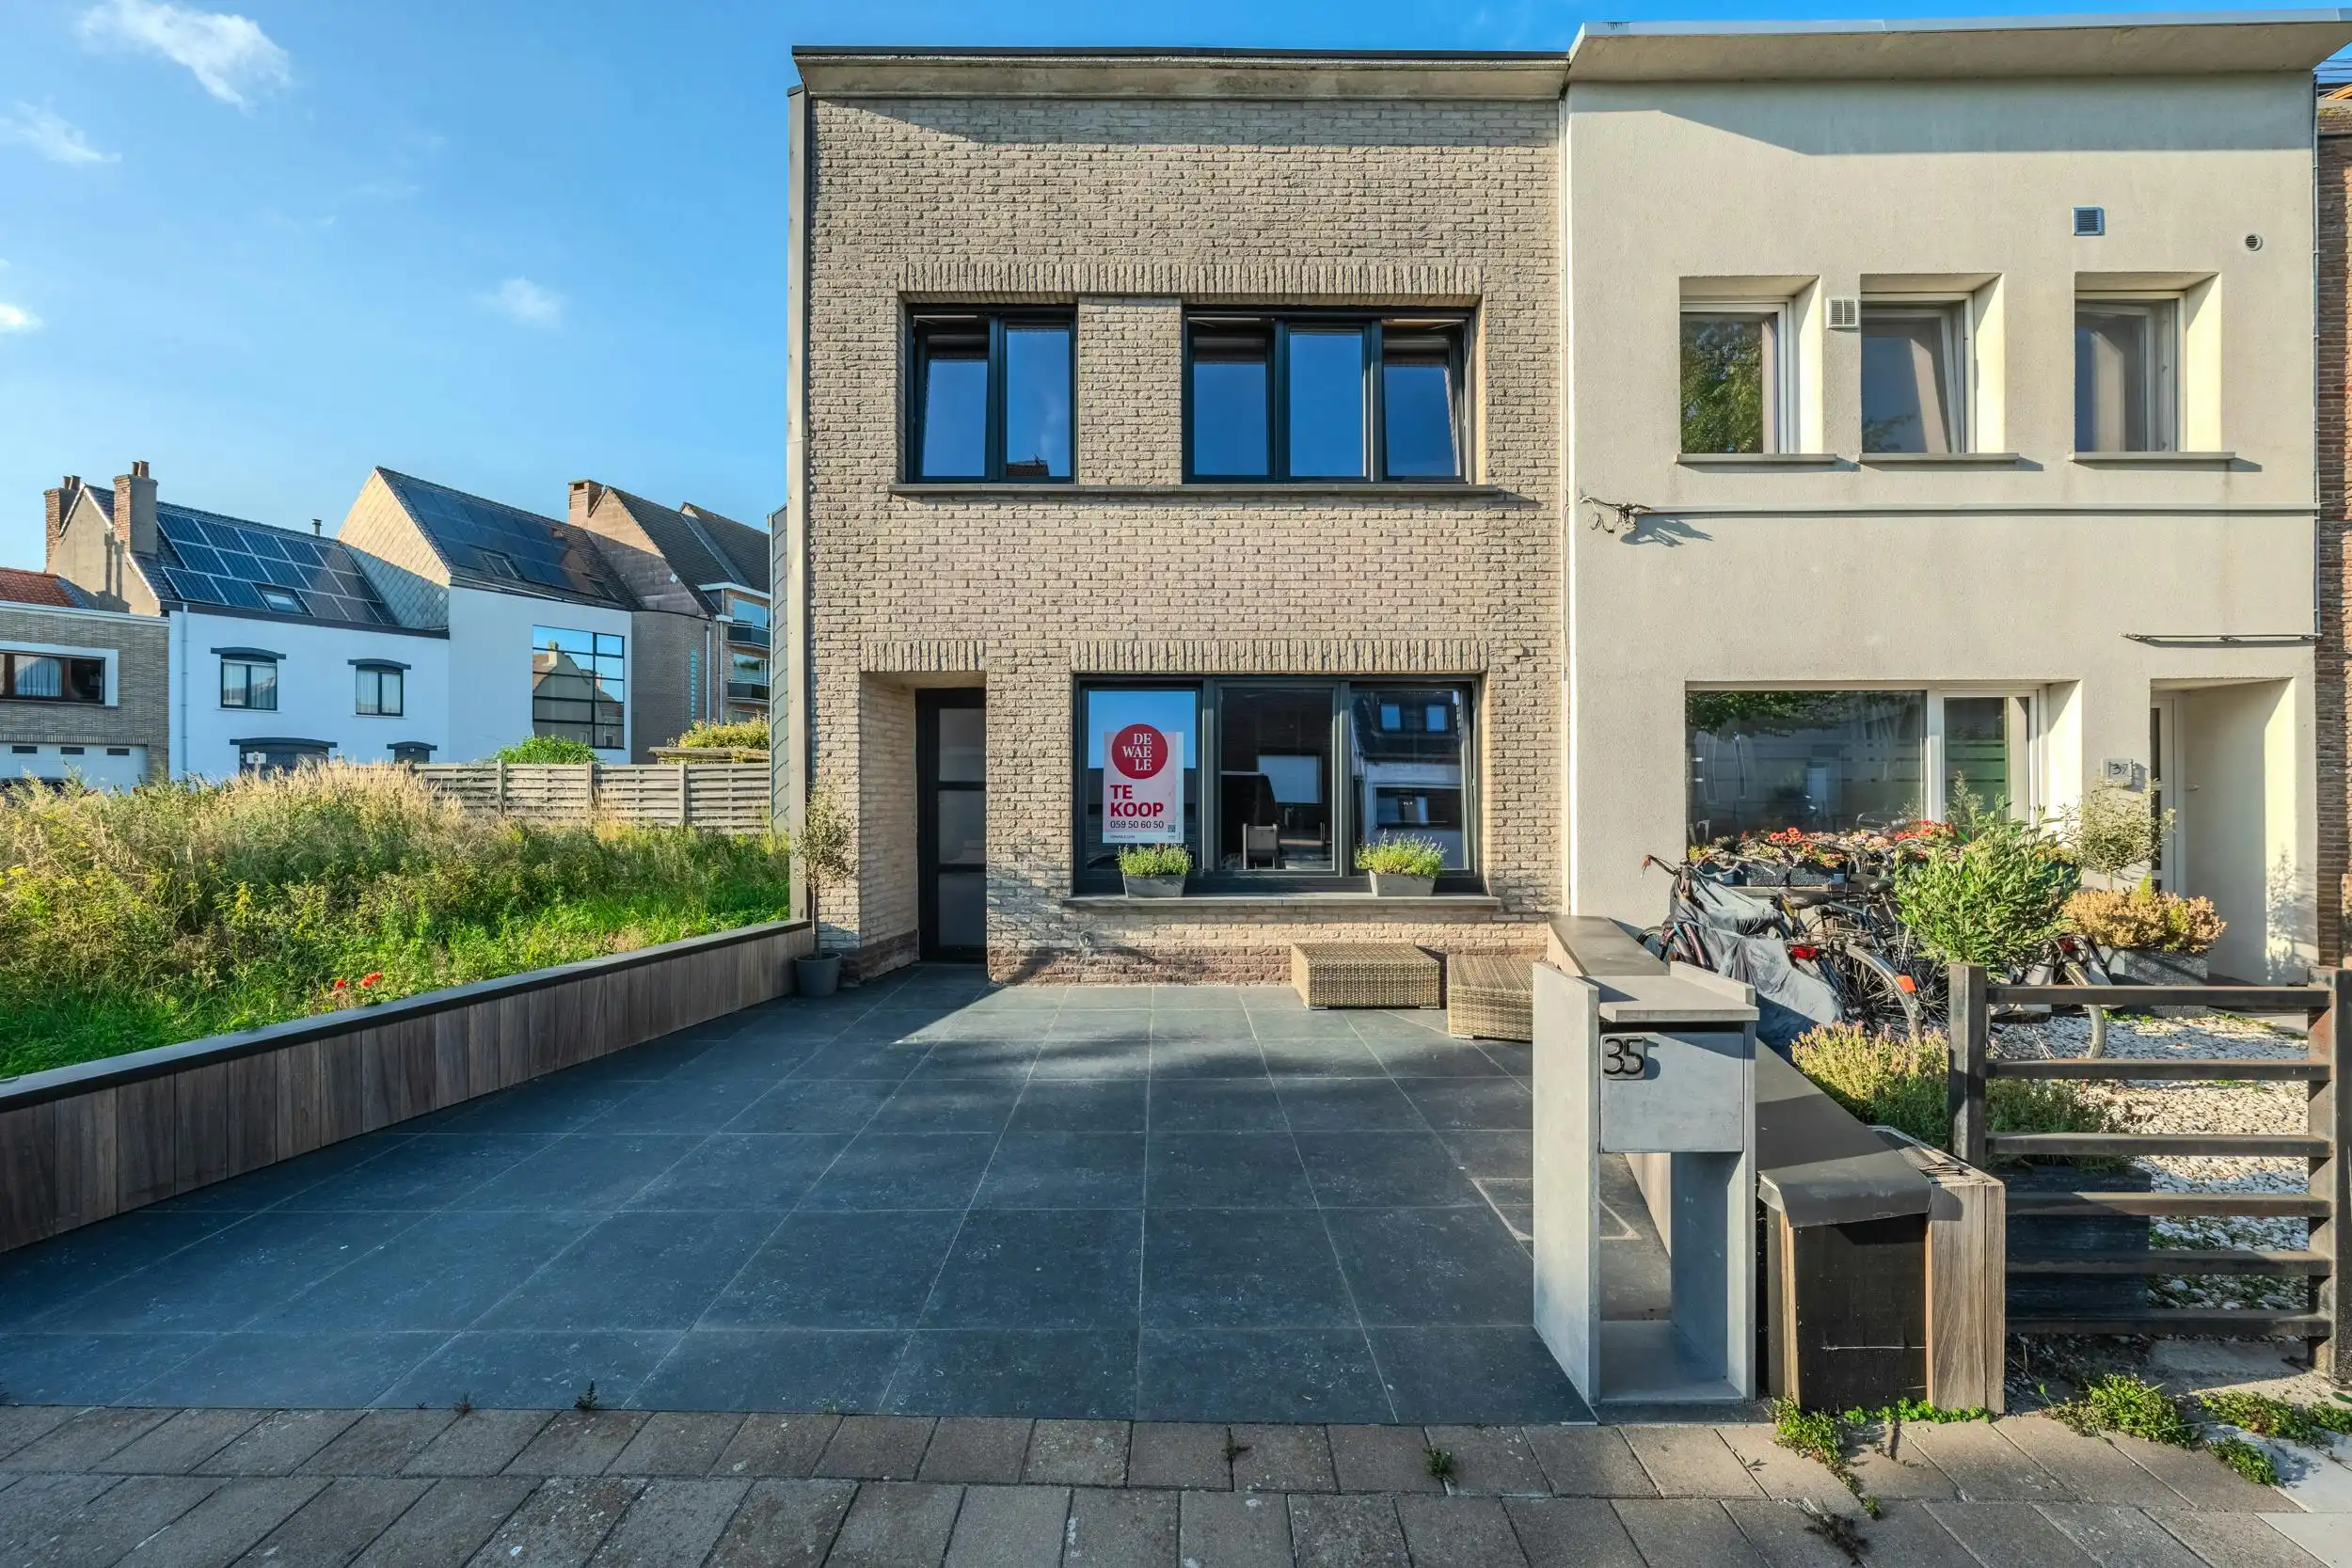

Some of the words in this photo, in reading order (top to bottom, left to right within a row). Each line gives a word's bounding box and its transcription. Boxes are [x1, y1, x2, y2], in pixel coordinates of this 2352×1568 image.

[1133, 733, 1152, 745] DE
[1122, 746, 1152, 758] WAE
[1135, 759, 1152, 771] LE
[2112, 763, 2129, 775] 37
[1110, 784, 1133, 800] TE
[1110, 801, 1164, 817] KOOP
[1110, 820, 1126, 829] 059
[1128, 820, 1139, 829] 50
[1140, 820, 1152, 829] 60
[1153, 820, 1164, 829] 50
[1604, 1038, 1645, 1074] 35
